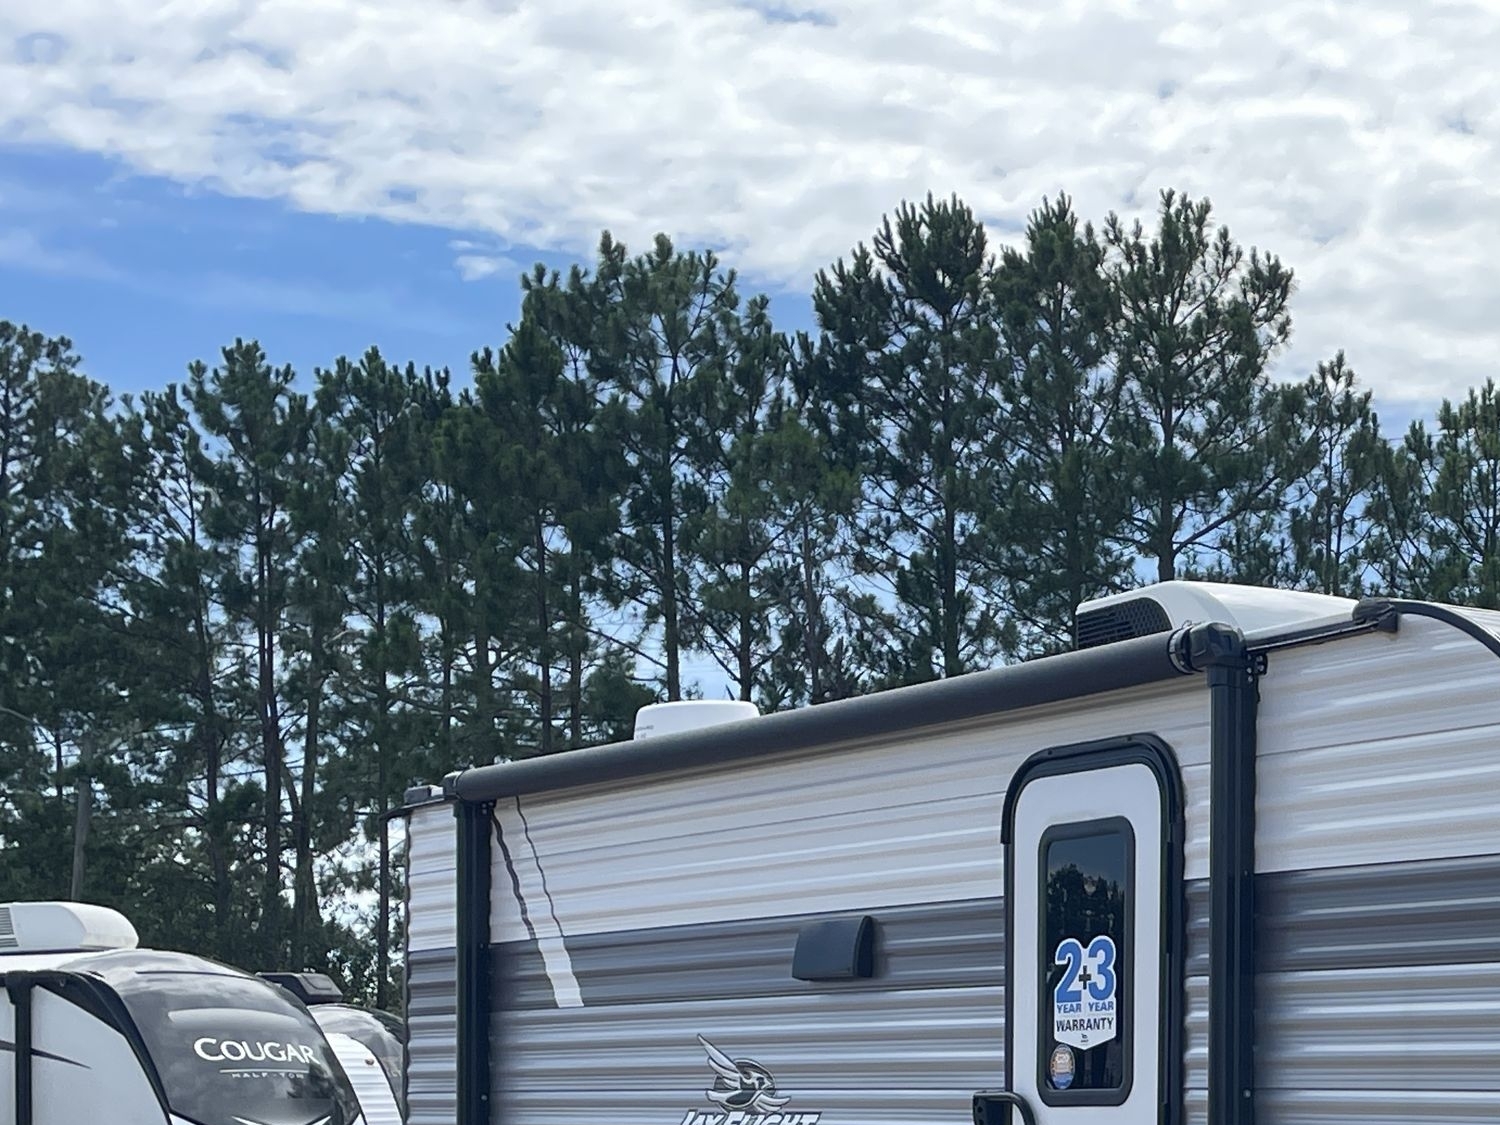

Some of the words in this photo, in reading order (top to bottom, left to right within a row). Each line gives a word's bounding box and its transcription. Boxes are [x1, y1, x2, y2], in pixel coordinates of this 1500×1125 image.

[1057, 1003, 1082, 1014] YEAR
[1088, 1000, 1114, 1012] YEAR
[1056, 1017, 1114, 1032] WARRANTY
[193, 1037, 320, 1065] COUGAR
